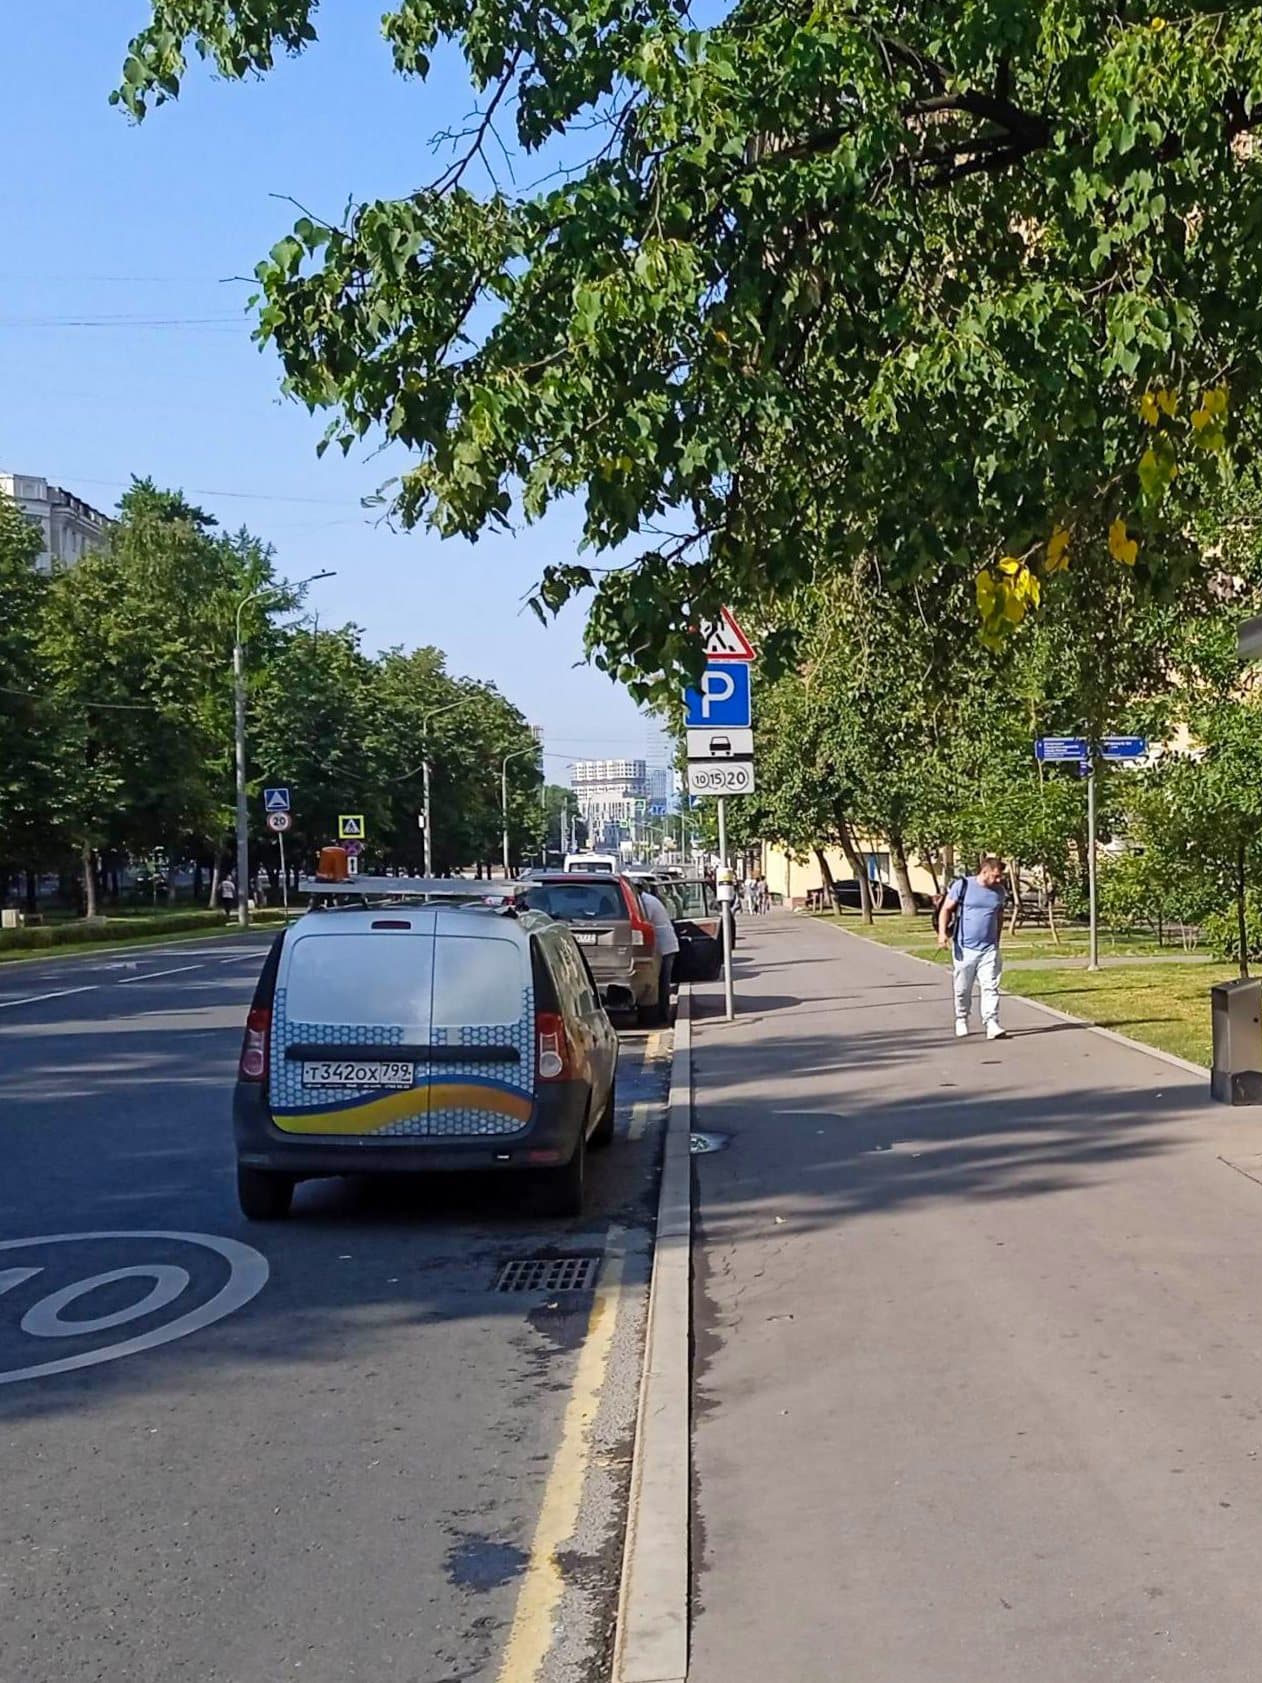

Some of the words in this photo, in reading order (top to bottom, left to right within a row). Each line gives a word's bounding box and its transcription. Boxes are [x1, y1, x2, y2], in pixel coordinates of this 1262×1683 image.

[701, 670, 734, 718] P
[695, 775, 706, 784] 10
[710, 773, 722, 785] 15
[727, 771, 746, 785] 20
[273, 816, 287, 826] 20
[382, 1063, 410, 1077] 799
